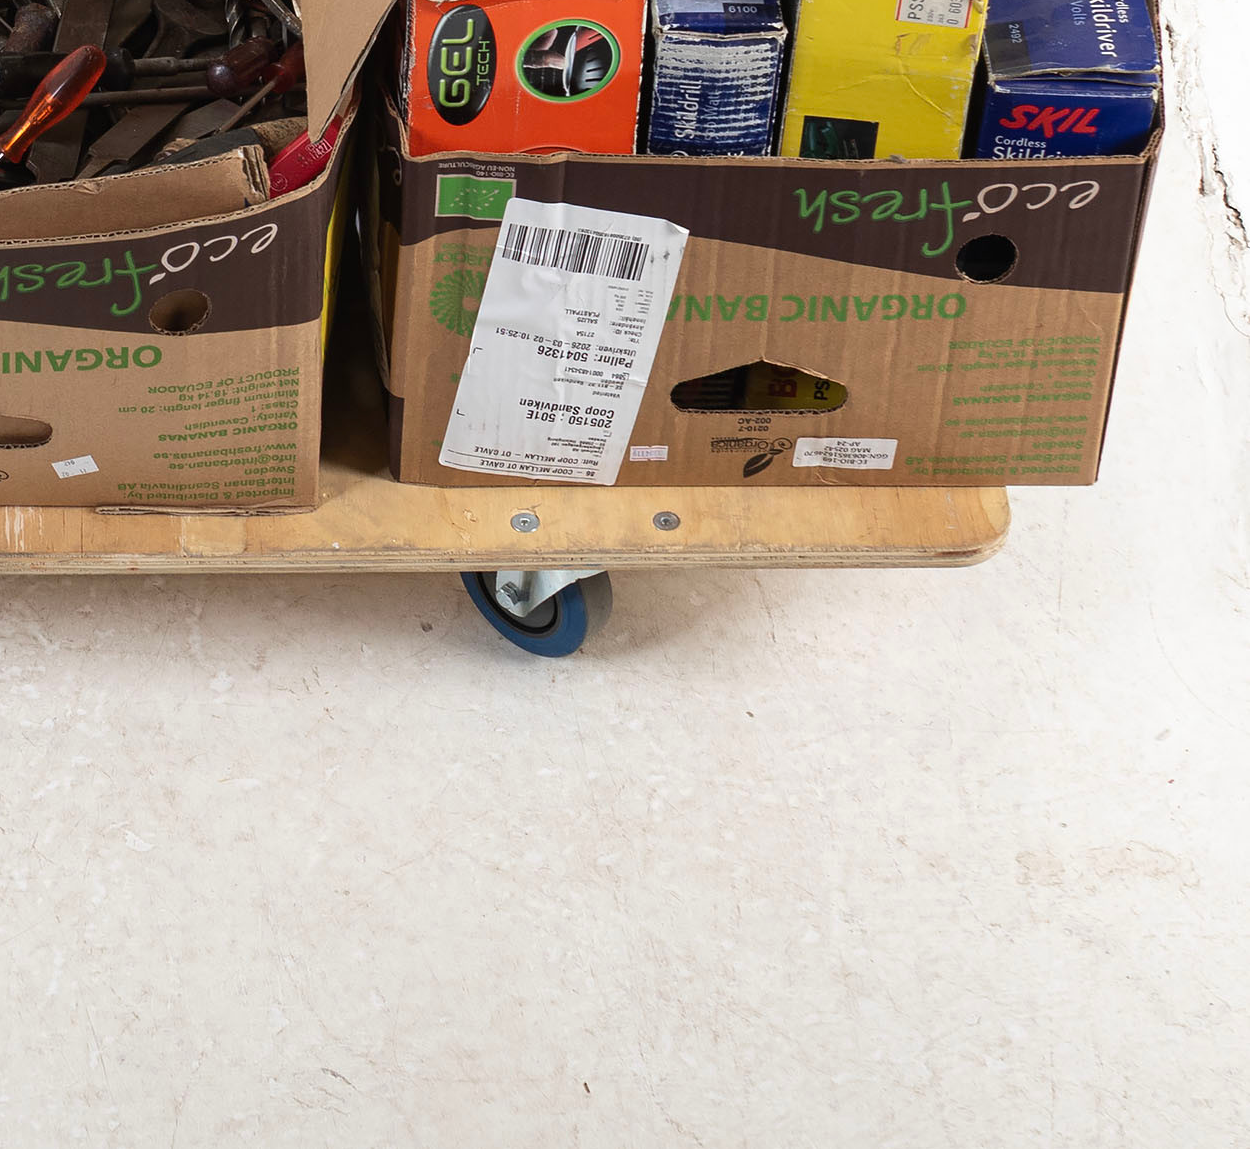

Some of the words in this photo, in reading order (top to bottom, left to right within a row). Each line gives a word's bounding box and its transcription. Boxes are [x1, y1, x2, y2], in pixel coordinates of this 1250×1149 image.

[1071, 0, 1085, 26] Volts
[1011, 23, 1020, 44] 2492
[439, 19, 474, 108] GEL
[476, 41, 490, 86] TECH
[674, 81, 702, 139] Skildrill
[999, 104, 1100, 138] SKIL
[995, 135, 1046, 148] Cordless
[438, 161, 485, 169] AGRICULTURE
[969, 180, 1100, 218] eco
[794, 182, 973, 257] fresh
[151, 222, 278, 280] eco
[564, 308, 599, 317] PLASTPALL
[781, 292, 967, 322] ORGANIC
[495, 326, 530, 340] 10:25:51
[536, 344, 588, 361] 5041326
[595, 344, 636, 356] Utskriven:
[593, 352, 633, 368] Pallnr:
[237, 366, 299, 383] PRODUCT
[147, 380, 212, 393] ECUADOR
[216, 377, 233, 387] OF
[231, 380, 275, 393] weight:
[278, 378, 299, 386] Net
[178, 393, 193, 401] kg
[197, 388, 227, 399] 18.14
[244, 388, 298, 401] Minimum
[158, 402, 201, 412] length:
[204, 396, 240, 408] finger
[260, 399, 298, 409] Class:
[518, 397, 580, 415] Sandviken
[140, 405, 154, 413] 20
[252, 410, 297, 421] Variety:
[525, 409, 555, 422] 501E
[584, 405, 614, 419] Coop
[184, 416, 248, 430] Cavendish
[231, 421, 297, 434] ORGANIC
[567, 415, 612, 428] 205150
[158, 429, 227, 441] BANANAS
[153, 443, 296, 459] www.freshbananas.se
[524, 452, 555, 461] MELLAN
[168, 454, 295, 469] info@interbanan.se
[244, 465, 295, 475] Sweden
[519, 464, 549, 473] MELLAN
[552, 467, 573, 475] COOP
[140, 481, 219, 490] Scandinavia
[224, 477, 294, 488] InterBanan
[123, 490, 141, 499] by:
[146, 491, 218, 500] Distributed
[222, 491, 231, 499] &
[235, 487, 294, 497] Imported
